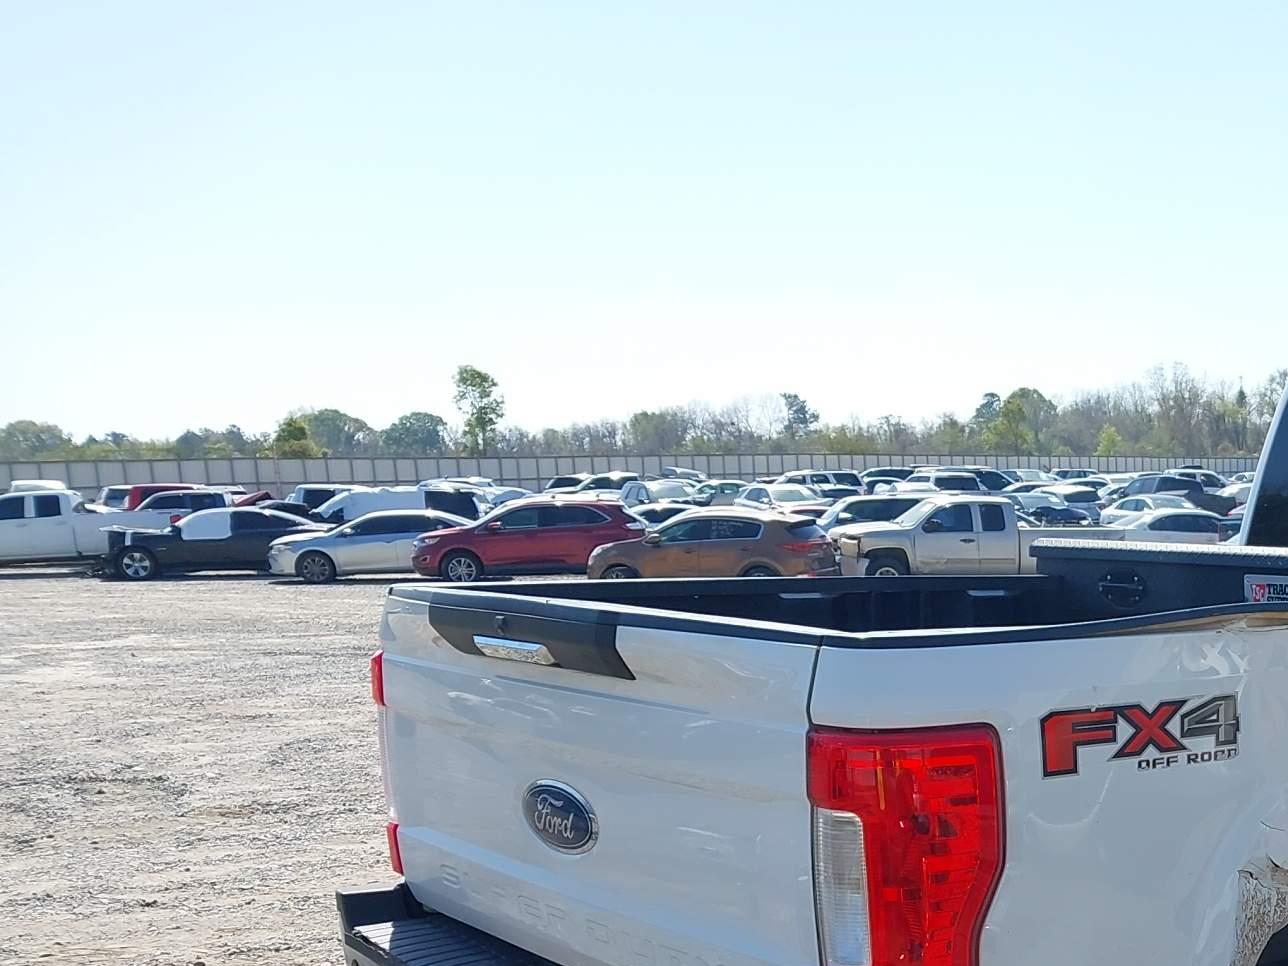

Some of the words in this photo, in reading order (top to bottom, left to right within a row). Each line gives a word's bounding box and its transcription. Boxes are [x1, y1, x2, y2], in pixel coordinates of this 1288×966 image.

[1040, 693, 1240, 778] FX4
[1137, 756, 1179, 771] OFF
[534, 793, 575, 839] Ford
